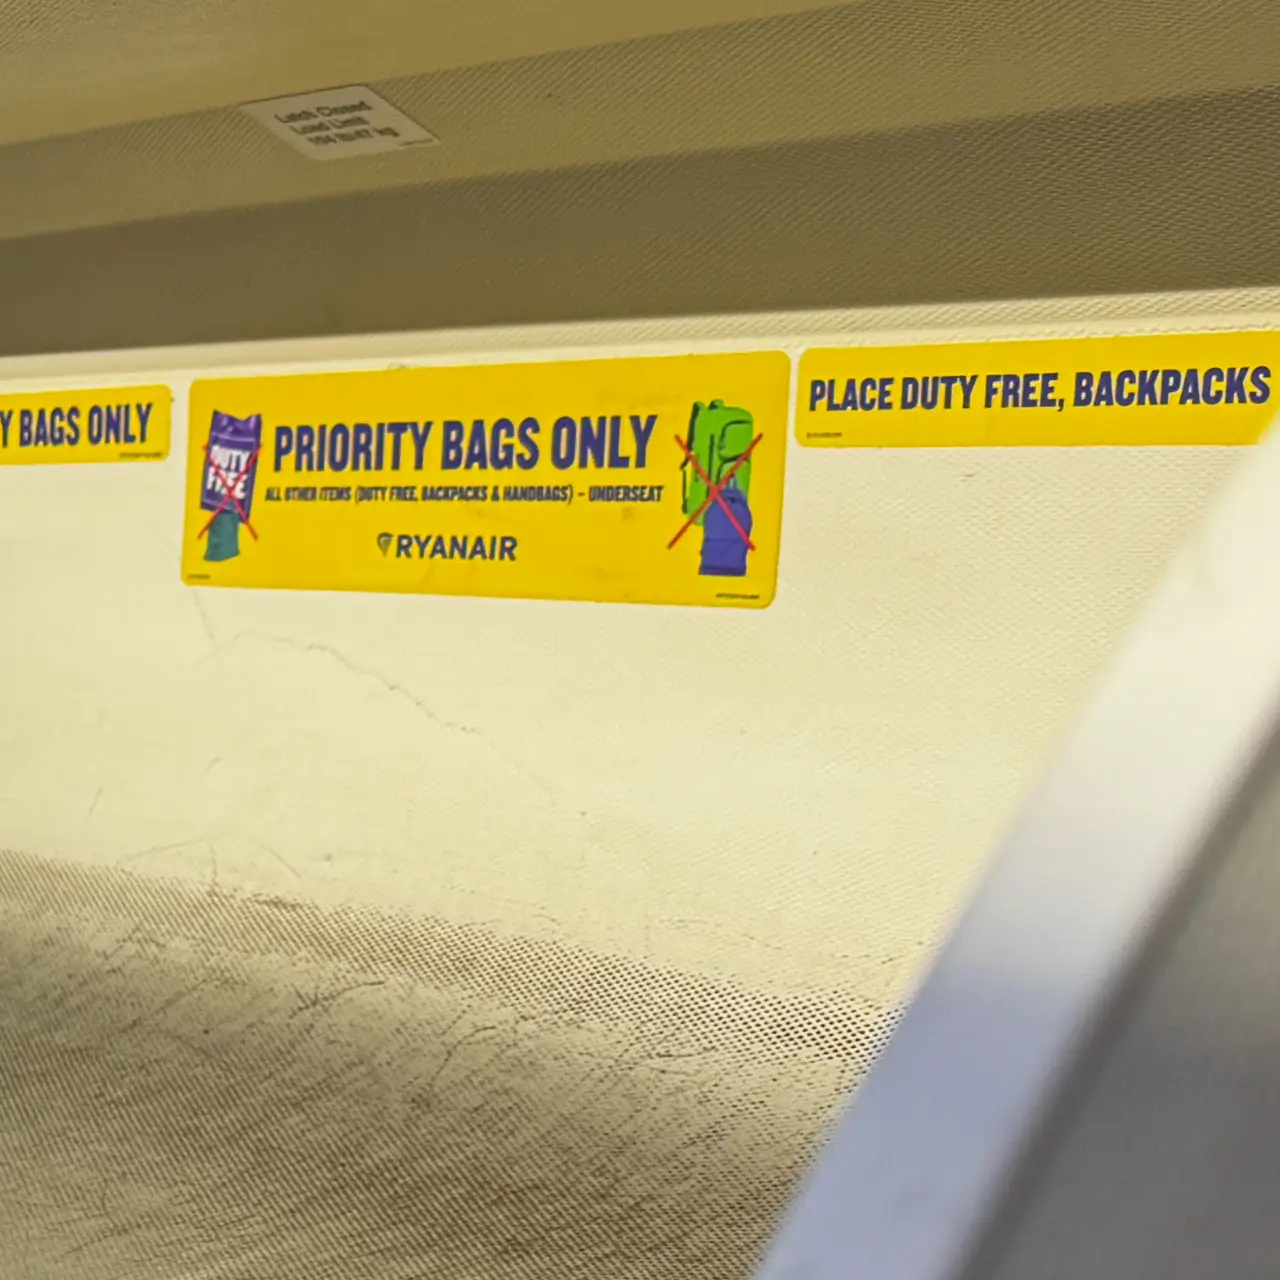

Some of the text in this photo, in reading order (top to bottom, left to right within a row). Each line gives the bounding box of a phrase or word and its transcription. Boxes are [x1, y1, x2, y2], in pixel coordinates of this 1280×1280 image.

[809, 365, 1271, 412] PLACE DUTY FREE, BACKPACKS
[19, 406, 81, 447] BAGS
[88, 402, 153, 445] ONLY
[273, 414, 658, 472] PRIORITY BAGS ONLY
[265, 486, 282, 501] ALL
[285, 486, 317, 501] OTHER
[320, 486, 351, 501] ITEMS
[421, 485, 488, 502] BACKPACKS
[589, 485, 664, 502] UNDERSEAT
[396, 534, 518, 561] RYANAIR
